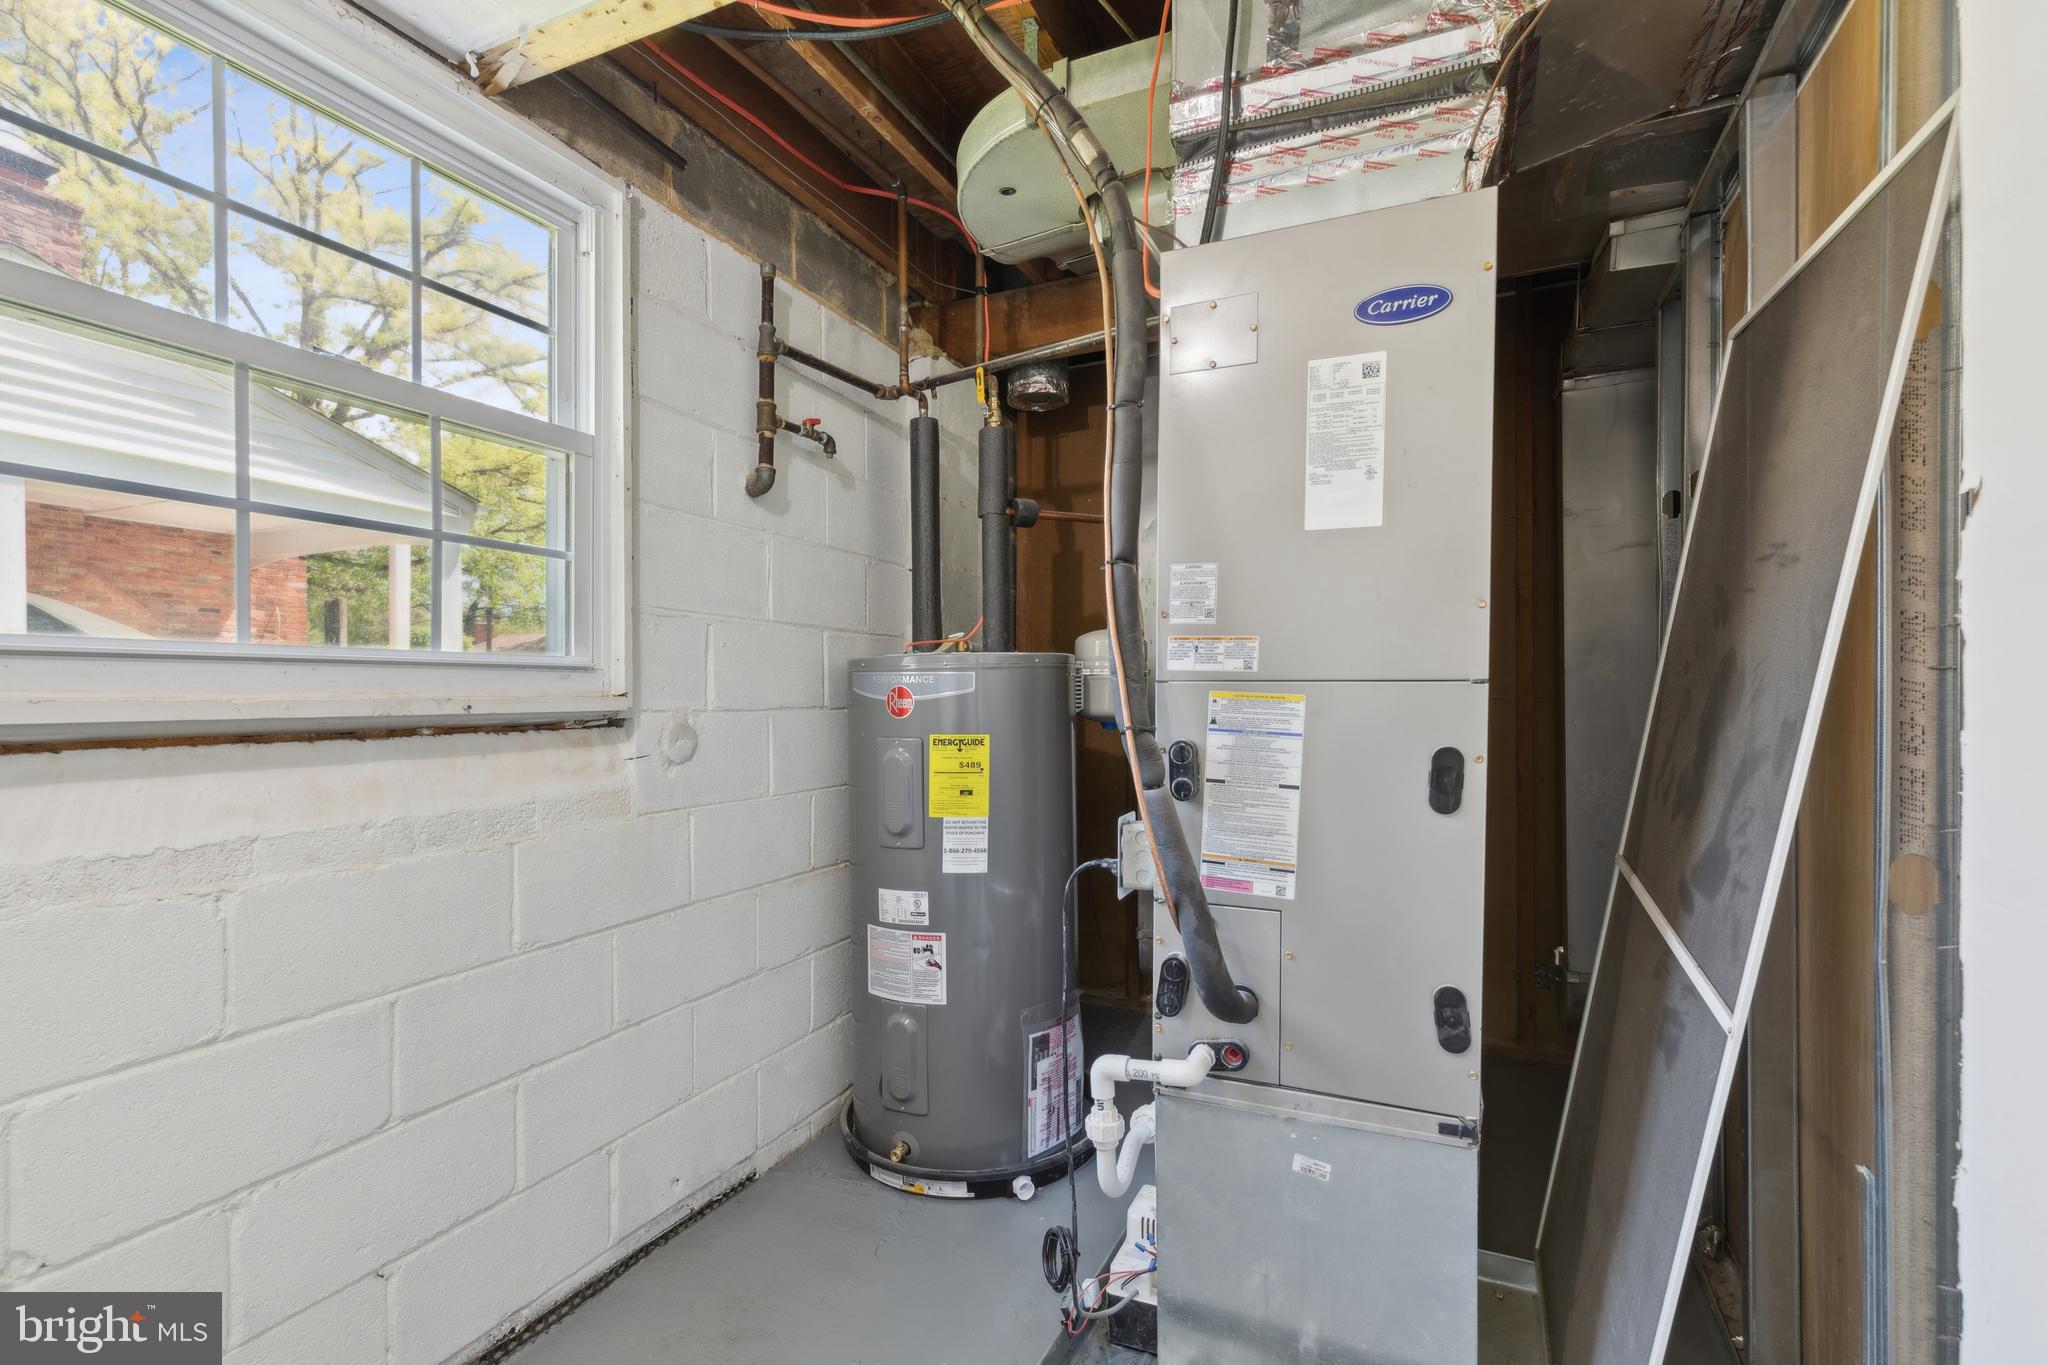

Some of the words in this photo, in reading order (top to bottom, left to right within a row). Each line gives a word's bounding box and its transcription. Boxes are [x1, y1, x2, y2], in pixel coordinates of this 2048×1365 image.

[1366, 291, 1439, 317] Carrier
[872, 675, 935, 684] PERFORMANCE
[889, 686, 913, 713] Rheem
